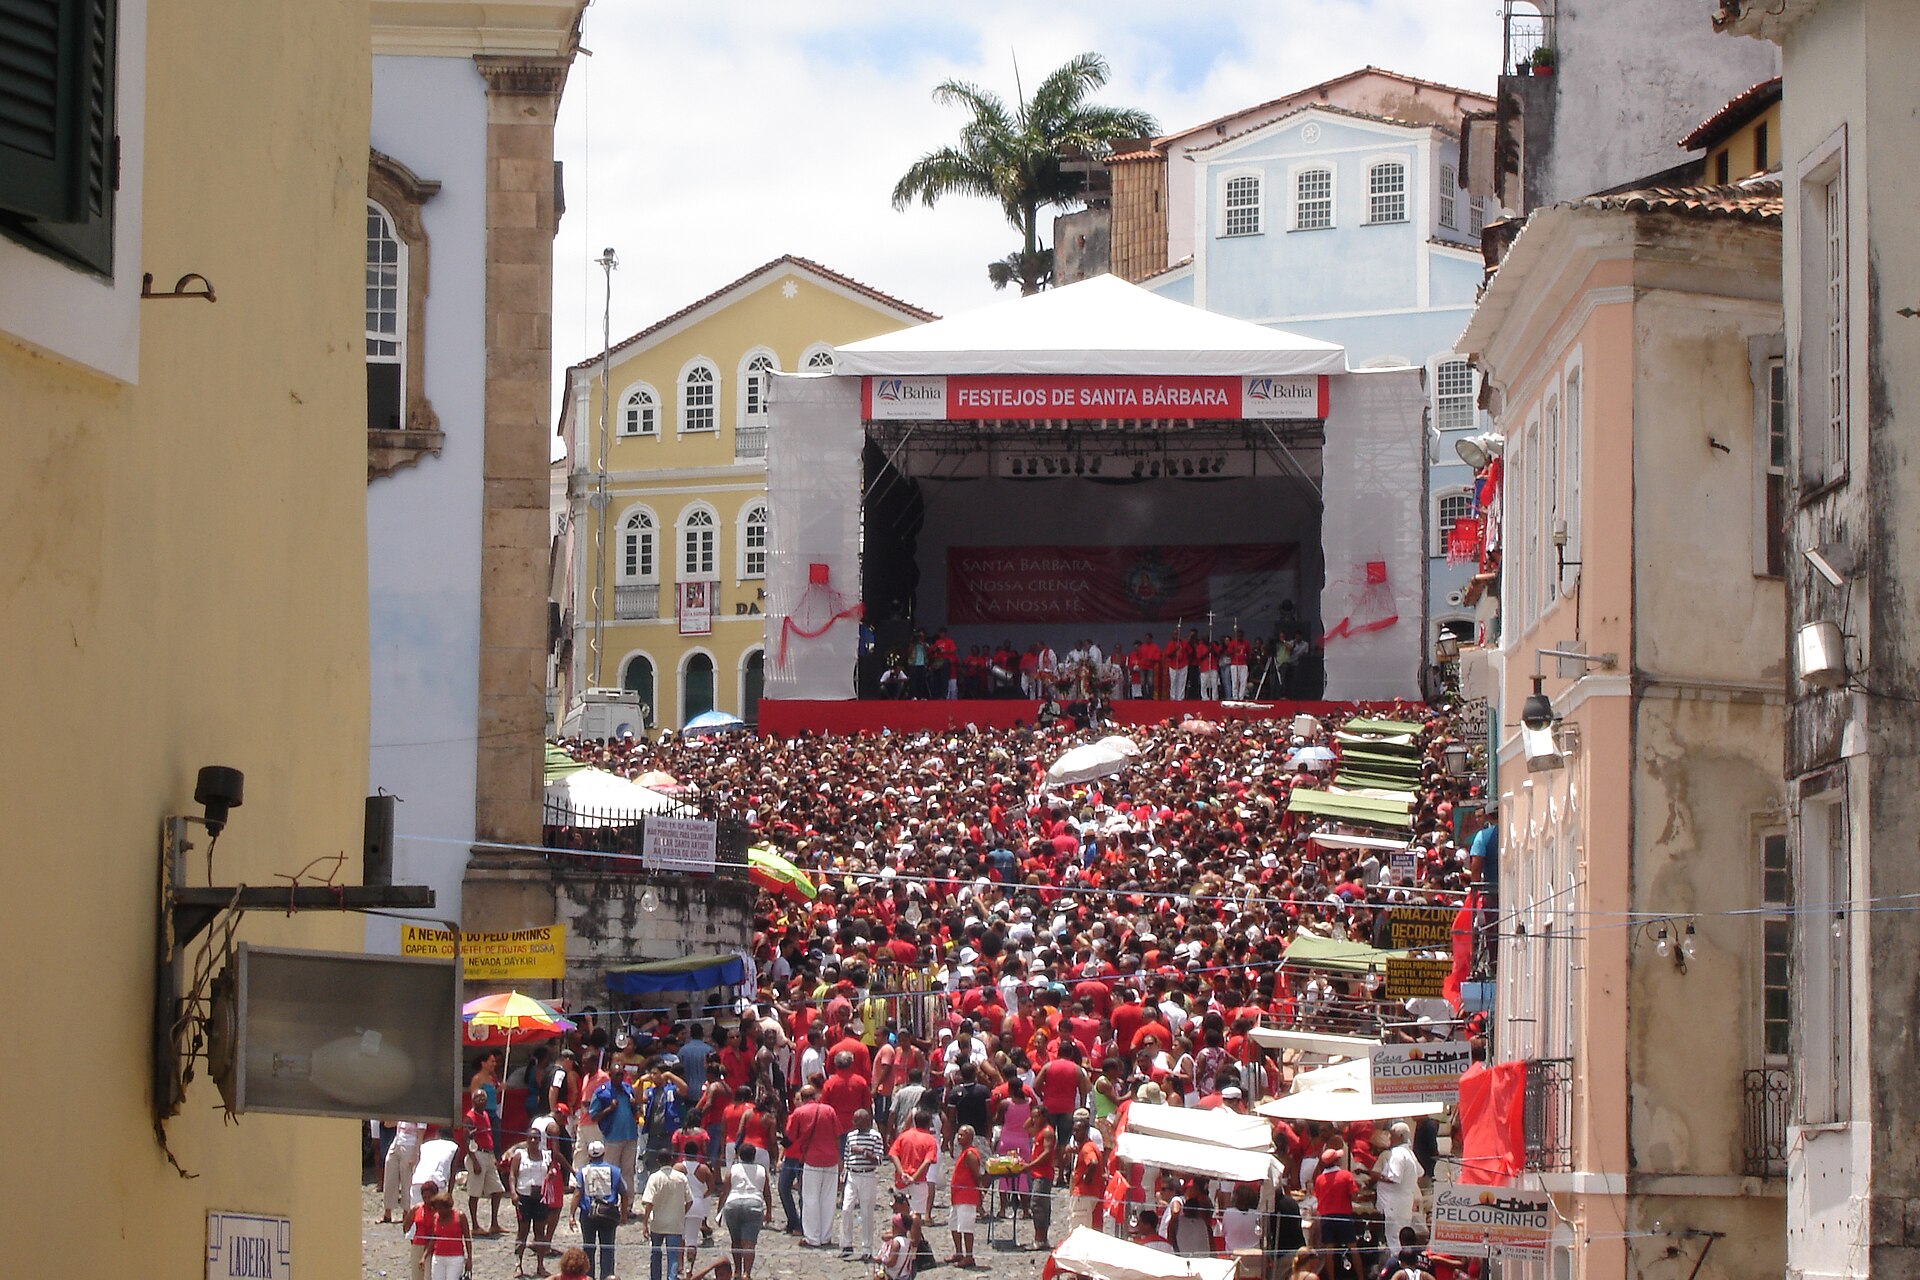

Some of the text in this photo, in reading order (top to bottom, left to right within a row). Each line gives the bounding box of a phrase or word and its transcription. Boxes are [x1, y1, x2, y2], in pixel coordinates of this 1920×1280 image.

[903, 386, 941, 400] Bahia
[958, 385, 1229, 406] FESTEJOS DE SANTA BÁRBARA
[1273, 384, 1312, 398] Bahia
[962, 559, 1015, 572] SANTA
[970, 579, 1090, 595] NOSSA CRENÇA
[736, 602, 761, 615] DA
[988, 599, 1001, 612] A
[1006, 599, 1061, 612] NOSSA
[408, 927, 415, 941] A
[512, 928, 551, 941] DRINKS
[405, 944, 438, 954] CAPETA
[485, 945, 496, 954] DE
[498, 944, 528, 954] FRUTAS
[468, 957, 501, 967] NEVADA
[1373, 1050, 1404, 1065] Casa
[1373, 1063, 1469, 1077] PELOURINHO
[1436, 1190, 1472, 1206] Casa
[1435, 1207, 1548, 1228] PELOURINHO
[229, 1235, 272, 1279] LADEIRA
